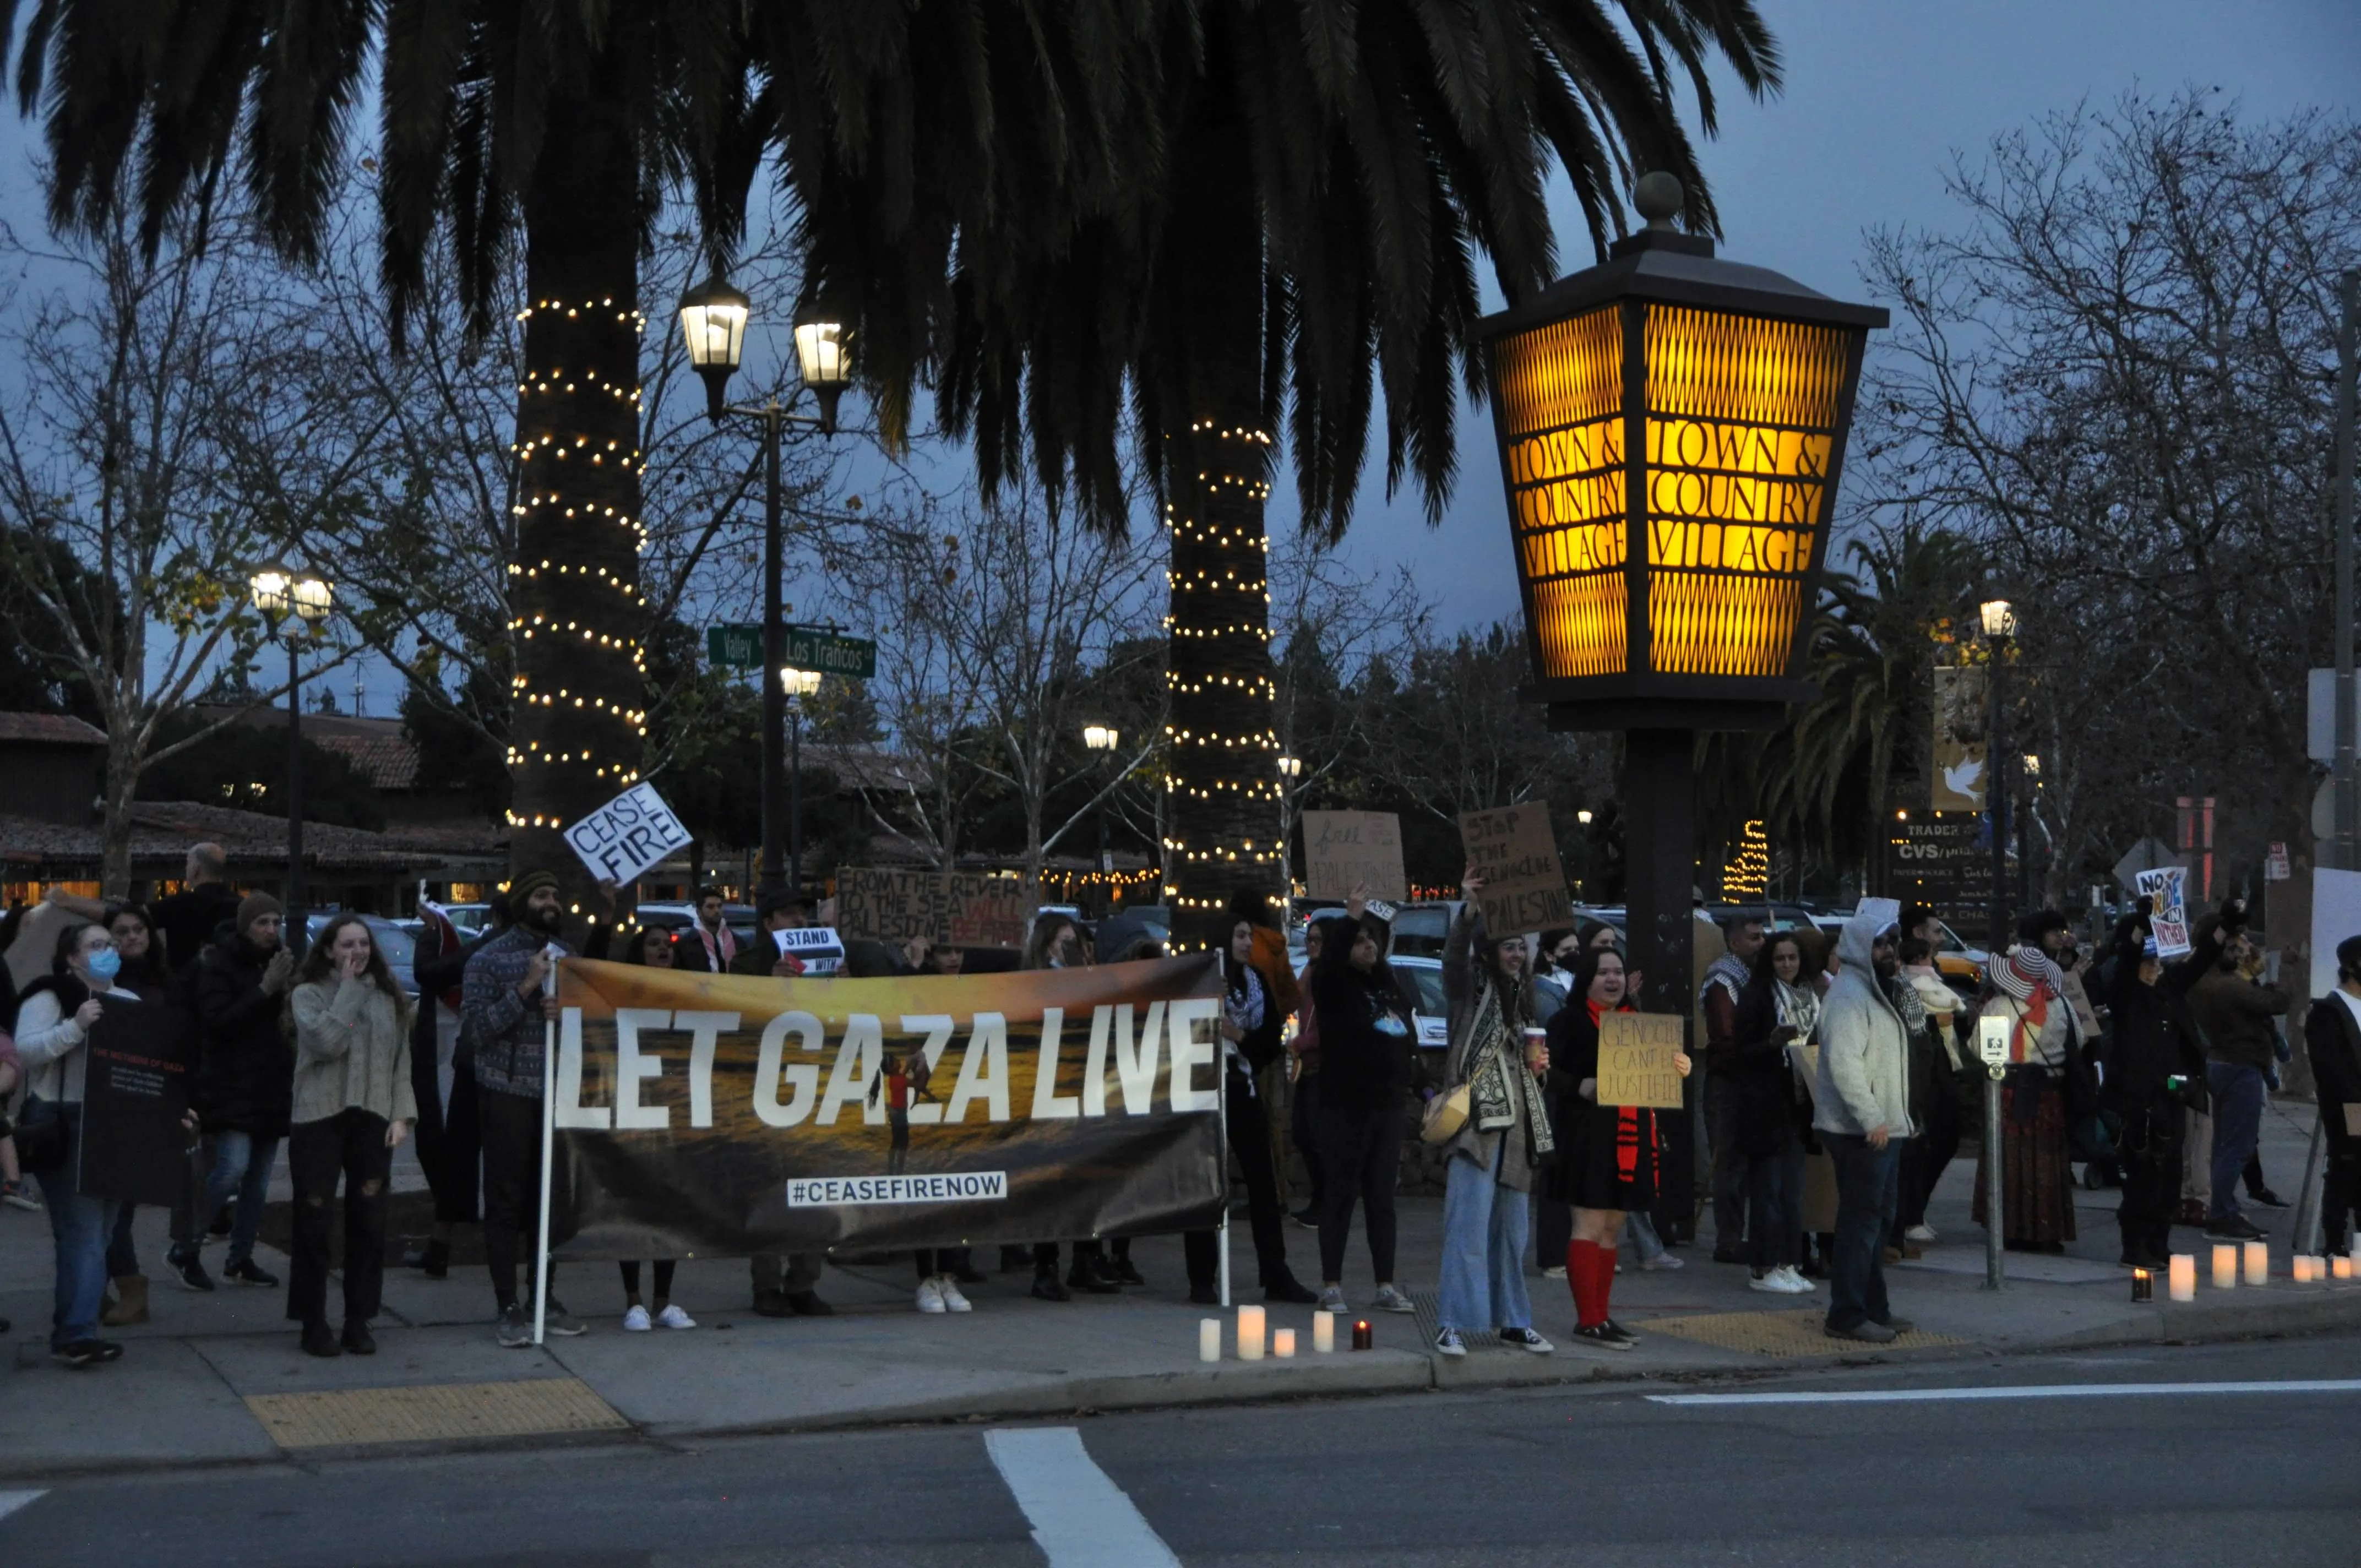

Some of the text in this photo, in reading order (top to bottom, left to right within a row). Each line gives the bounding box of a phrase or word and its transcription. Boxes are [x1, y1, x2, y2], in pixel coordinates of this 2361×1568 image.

[1509, 420, 1622, 484] TOWN &
[1647, 418, 1823, 478] TOWN &
[1516, 470, 1626, 530] COUNTRY
[1651, 470, 1824, 525] COUNTRY
[1523, 519, 1626, 578] VILLAGE
[1649, 520, 1814, 572] VILLAGE
[724, 633, 751, 662] Valley
[786, 633, 809, 662] Los
[814, 638, 862, 670] Trancos
[573, 787, 657, 853] CEASE
[1467, 812, 1519, 841] STOP
[1907, 825, 1959, 836] TRADER
[599, 809, 686, 881] FIRE!
[1471, 843, 1508, 863] THE
[837, 869, 1022, 898] FROM THE RIVER
[2140, 874, 2163, 893] NO
[2153, 875, 2181, 916] RIDE
[835, 891, 1020, 922] TO THE SEA WILL
[1366, 900, 1391, 918] ASE
[2168, 909, 2181, 922] IN
[786, 930, 829, 945] STAND
[953, 917, 978, 942] BE
[815, 957, 837, 971] WITH
[556, 998, 1220, 1129] LET GAZA LIVE
[792, 1174, 1002, 1203] #CEASEFIRENOW
